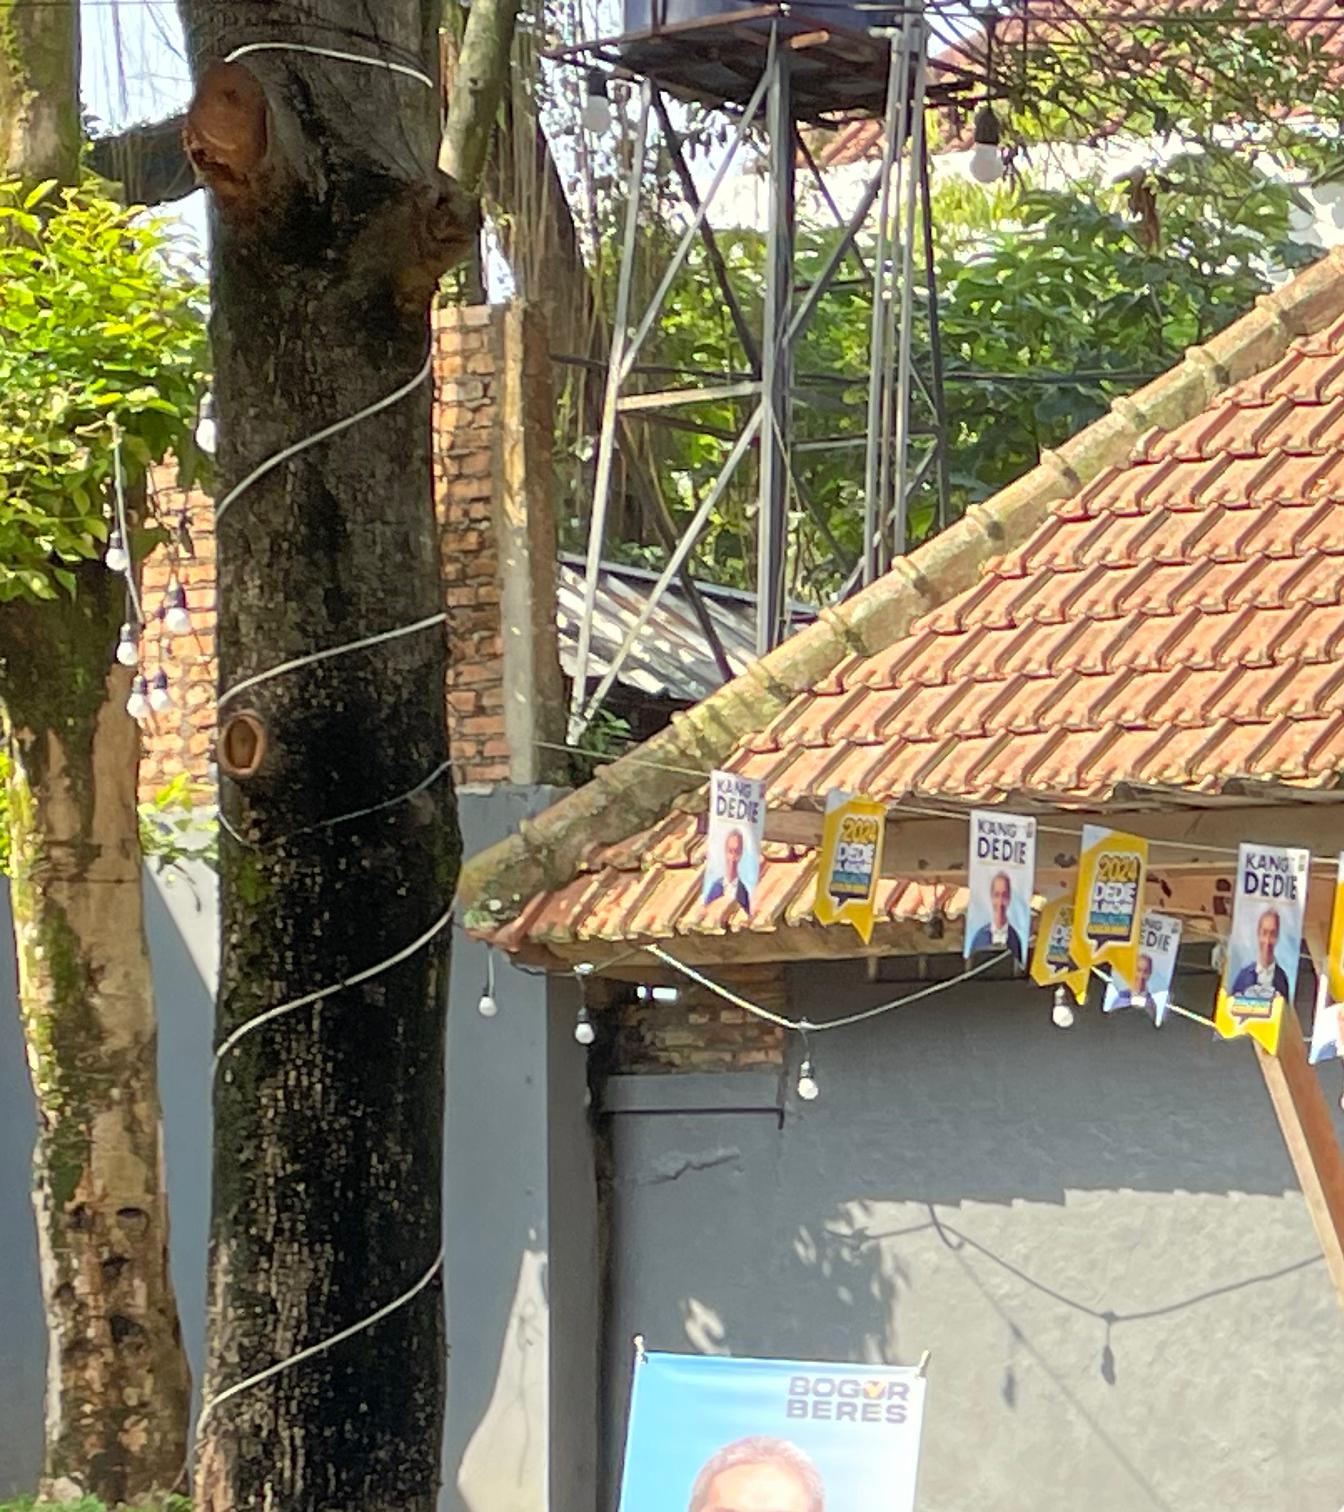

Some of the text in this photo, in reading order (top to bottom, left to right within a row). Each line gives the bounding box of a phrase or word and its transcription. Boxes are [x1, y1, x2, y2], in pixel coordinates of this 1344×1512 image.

[977, 836, 1028, 865] DEDIE
[1245, 853, 1290, 873] KANG
[1243, 871, 1298, 901] DEDIE
[788, 1376, 911, 1401] BOGOR
[785, 1398, 909, 1425] BERES
